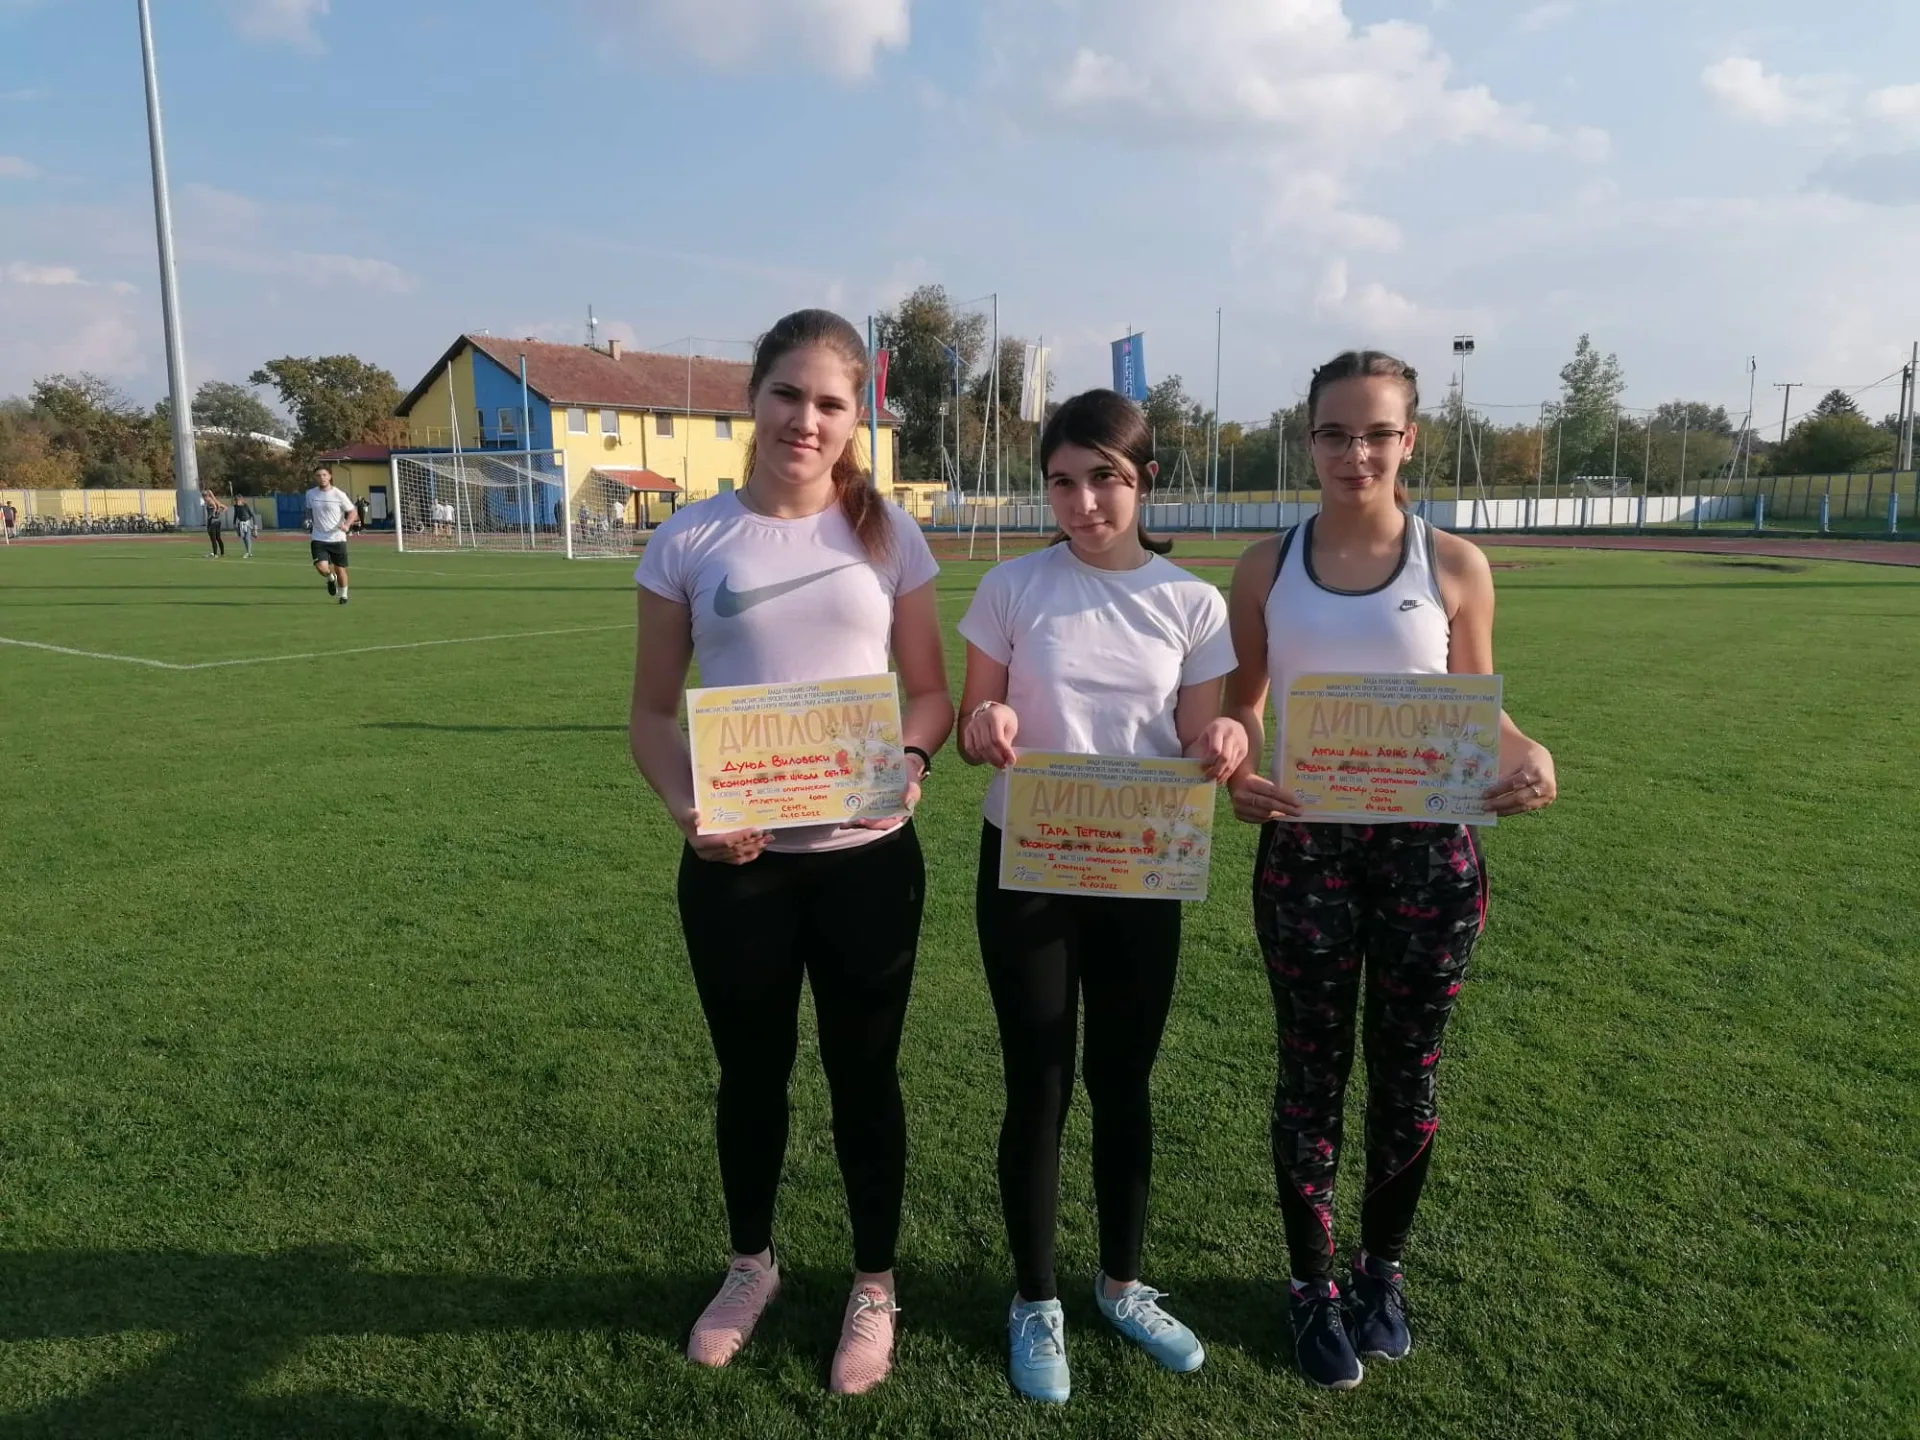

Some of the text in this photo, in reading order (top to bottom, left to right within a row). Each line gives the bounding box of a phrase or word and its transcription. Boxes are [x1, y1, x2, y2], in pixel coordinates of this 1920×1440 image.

[719, 705, 874, 754] ДИПЛОМУ
[1308, 699, 1472, 740] ДИПЛОМУ
[1030, 779, 1190, 821] ДИПЛОМУ
